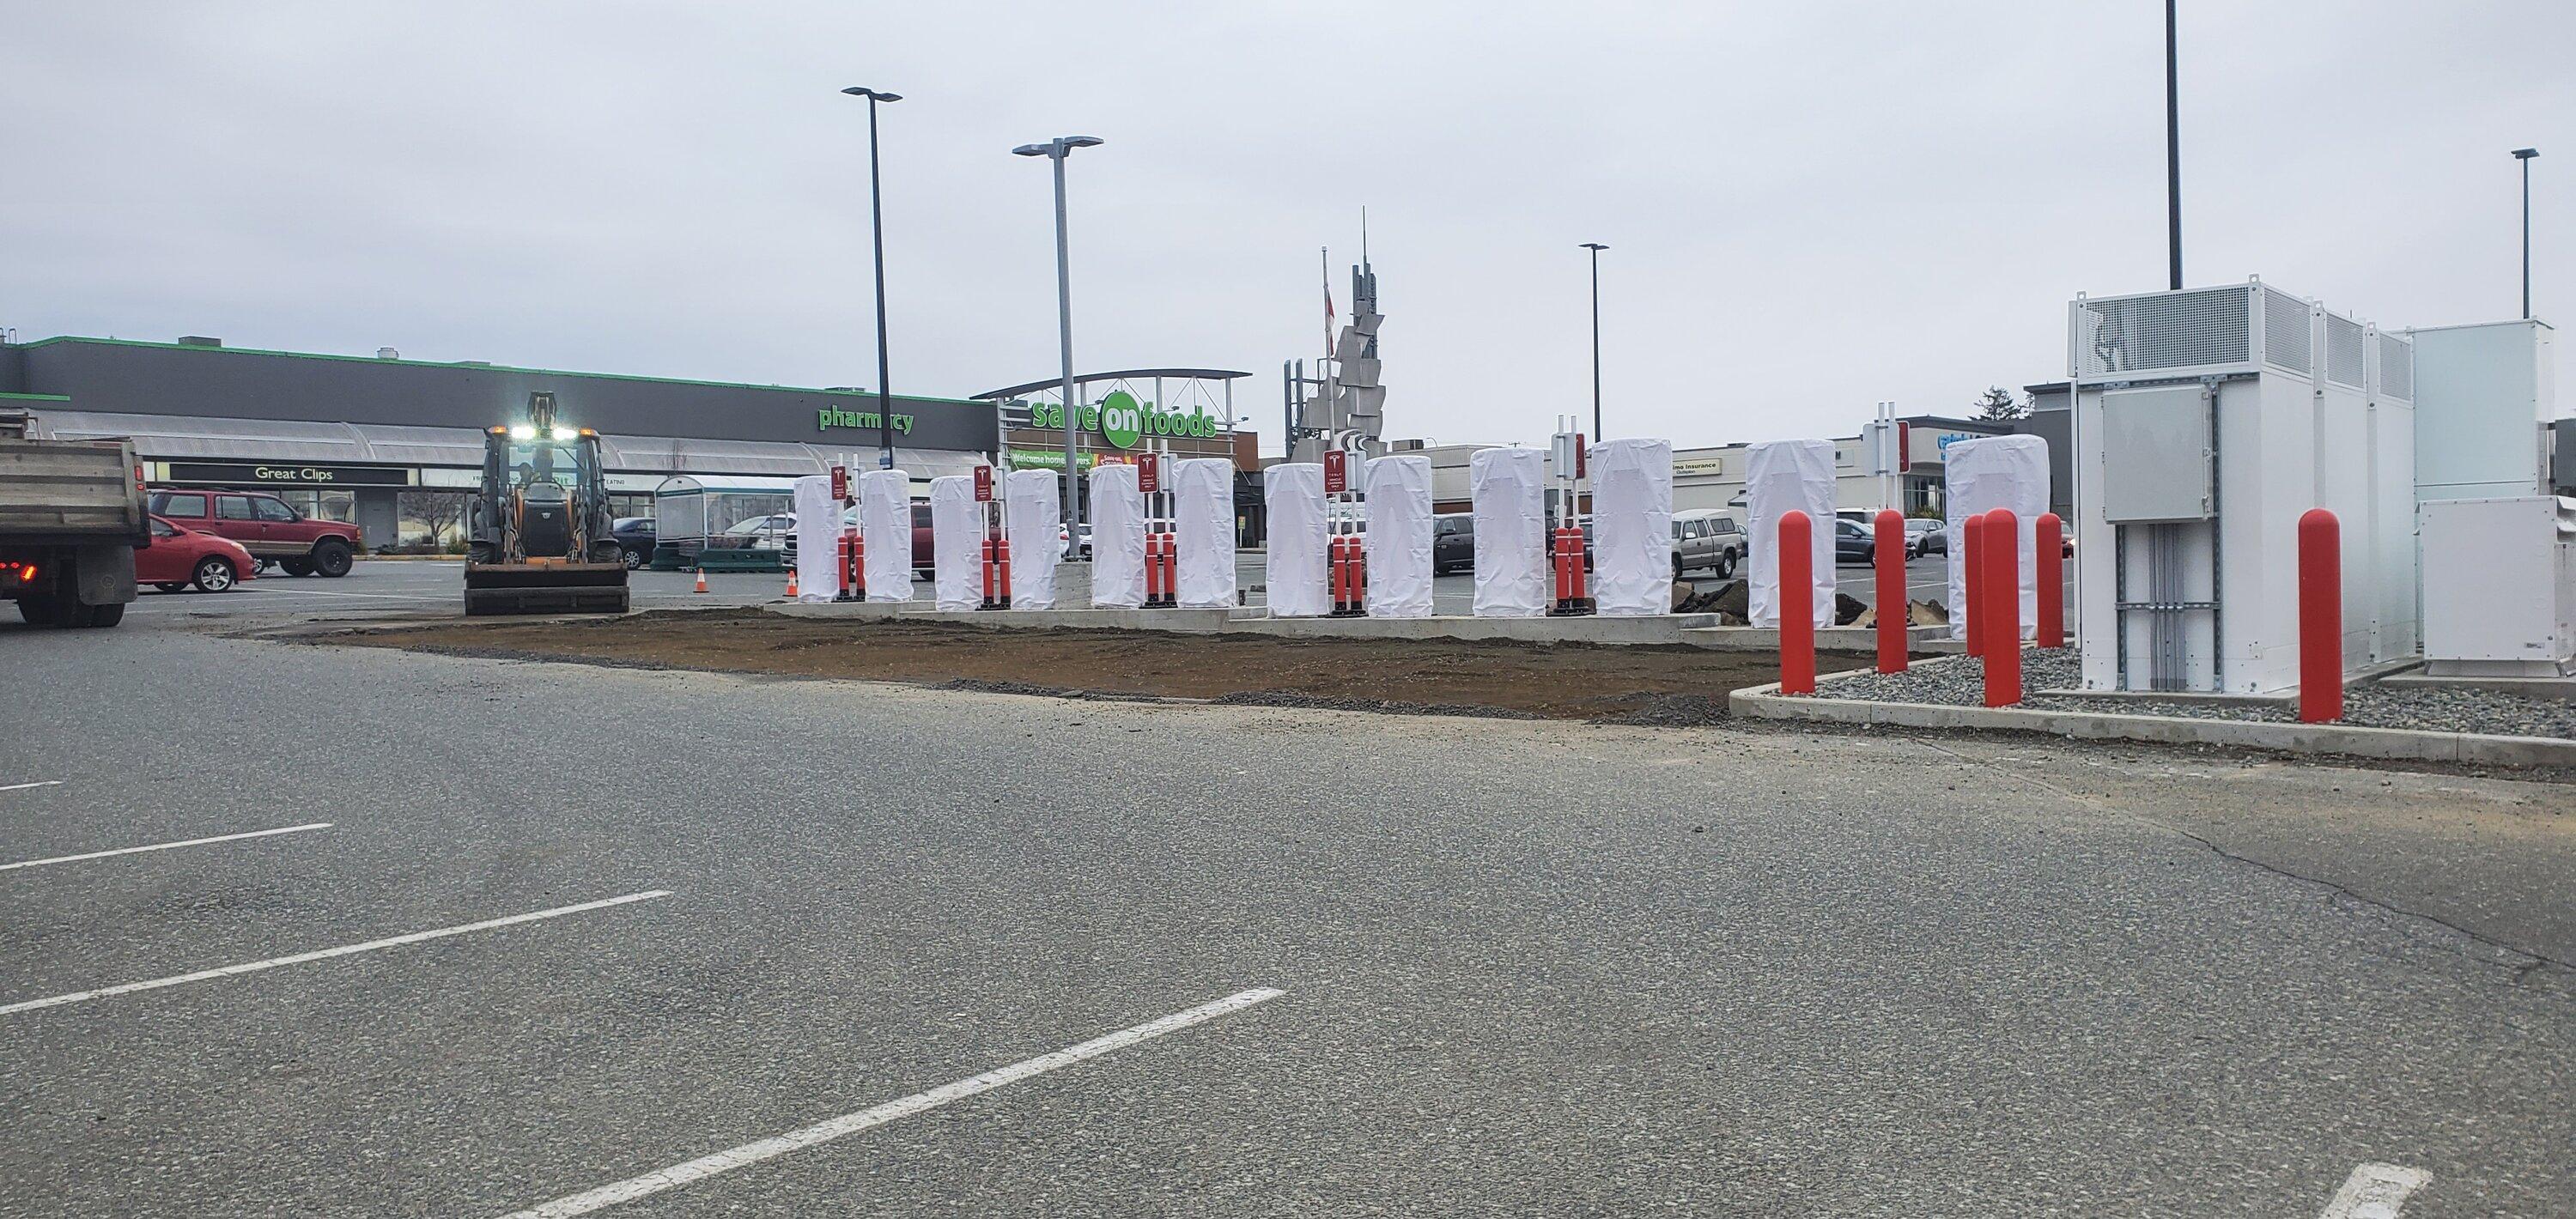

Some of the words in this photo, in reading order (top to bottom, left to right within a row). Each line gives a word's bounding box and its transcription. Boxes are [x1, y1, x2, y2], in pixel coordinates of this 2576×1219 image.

[818, 404, 914, 435] pharmcy
[1032, 402, 1099, 430] save
[1105, 408, 1139, 432] on
[1143, 401, 1217, 438] foods
[1013, 453, 1045, 464] Welcome
[255, 467, 296, 480] Great
[301, 468, 333, 482] Clips
